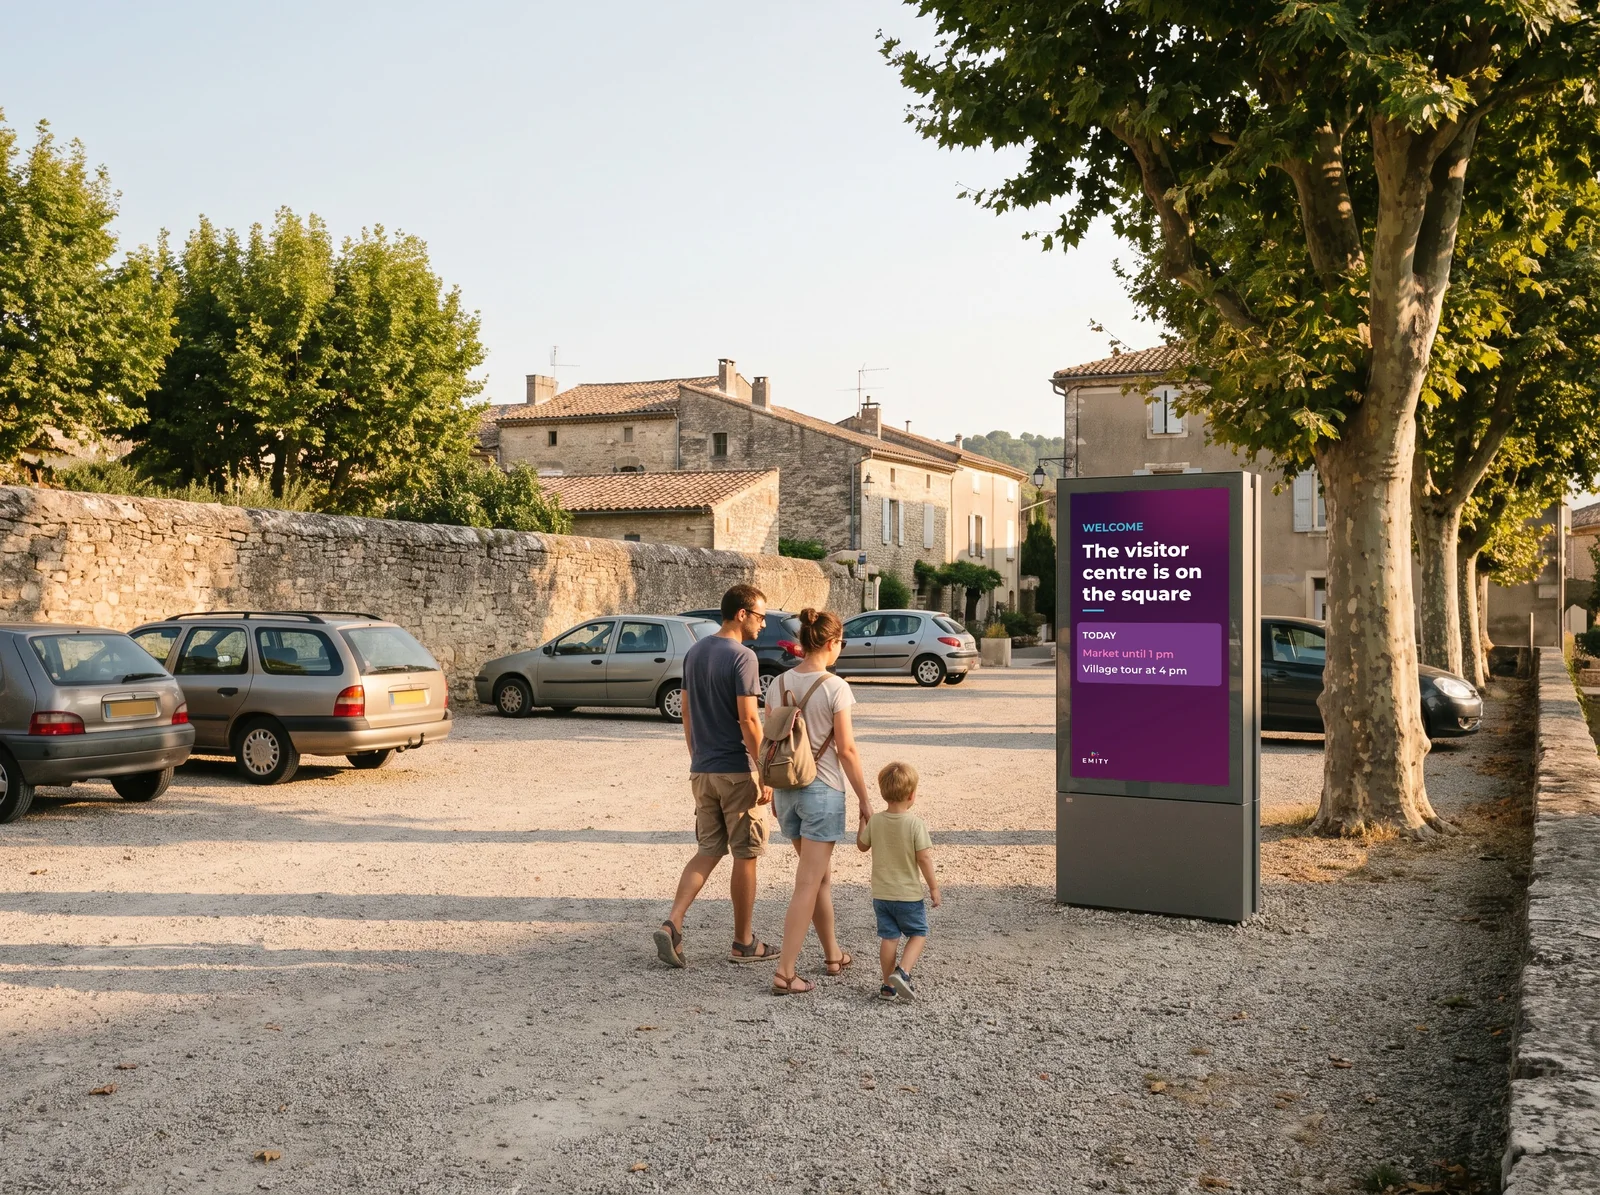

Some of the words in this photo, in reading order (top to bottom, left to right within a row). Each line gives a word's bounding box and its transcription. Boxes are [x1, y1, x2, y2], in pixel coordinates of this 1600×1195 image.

[1082, 522, 1144, 532] WELCOME
[1082, 543, 1119, 558] The
[1125, 541, 1189, 558] visitor
[1082, 565, 1147, 580] centre
[1153, 563, 1170, 580] is
[1175, 566, 1202, 579] on
[1082, 586, 1116, 601] the
[1121, 589, 1192, 604] square
[1082, 631, 1117, 640] TODAY
[1082, 649, 1119, 658] Market
[1122, 649, 1146, 658] until
[1148, 650, 1153, 659] 1
[1155, 651, 1174, 660] pm
[1082, 664, 1118, 676] Village
[1120, 665, 1142, 674] tour
[1145, 666, 1156, 675] at
[1159, 666, 1167, 675] 4
[1168, 667, 1187, 677] pm
[1082, 757, 1109, 765] EMITY
